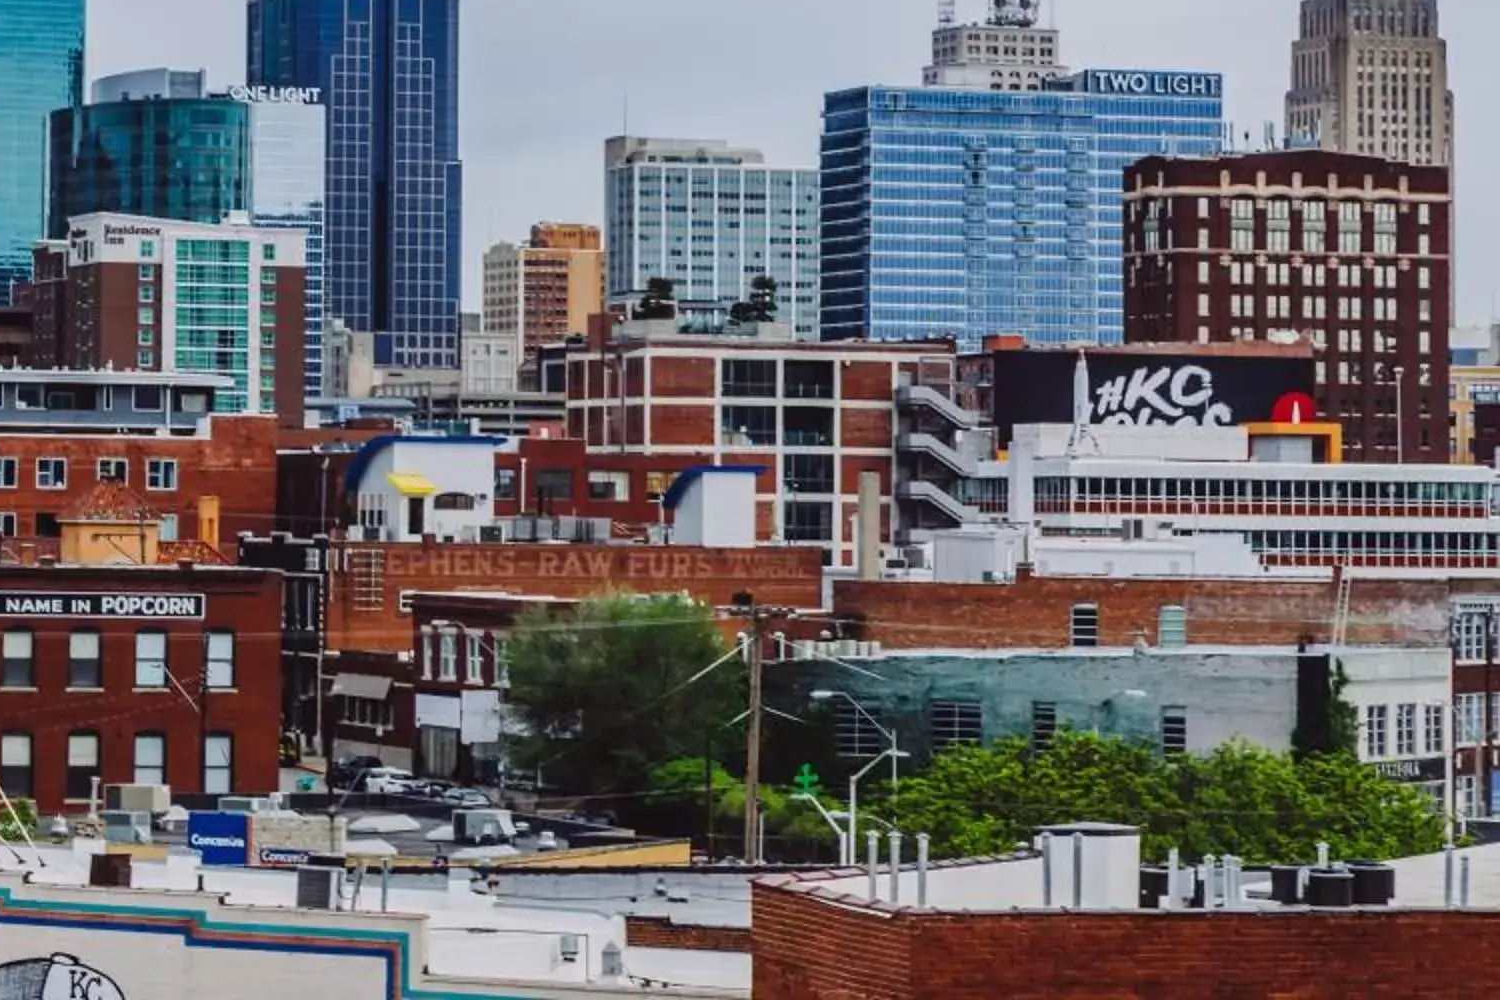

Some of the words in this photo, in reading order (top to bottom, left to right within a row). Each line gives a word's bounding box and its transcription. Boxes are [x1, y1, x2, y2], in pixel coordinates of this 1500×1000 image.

[1096, 71, 1147, 92] TWO
[1154, 74, 1219, 94] LIGHT
[229, 85, 267, 101] ONE
[270, 86, 321, 103] LIGHT
[104, 224, 161, 236] Residence
[104, 236, 125, 245] Inn
[1096, 364, 1212, 417] #KC
[628, 553, 712, 579] FURS
[6, 600, 63, 614] NAME
[72, 600, 91, 614] IN
[102, 597, 196, 615] POPCORN
[69, 970, 101, 1000] KC
